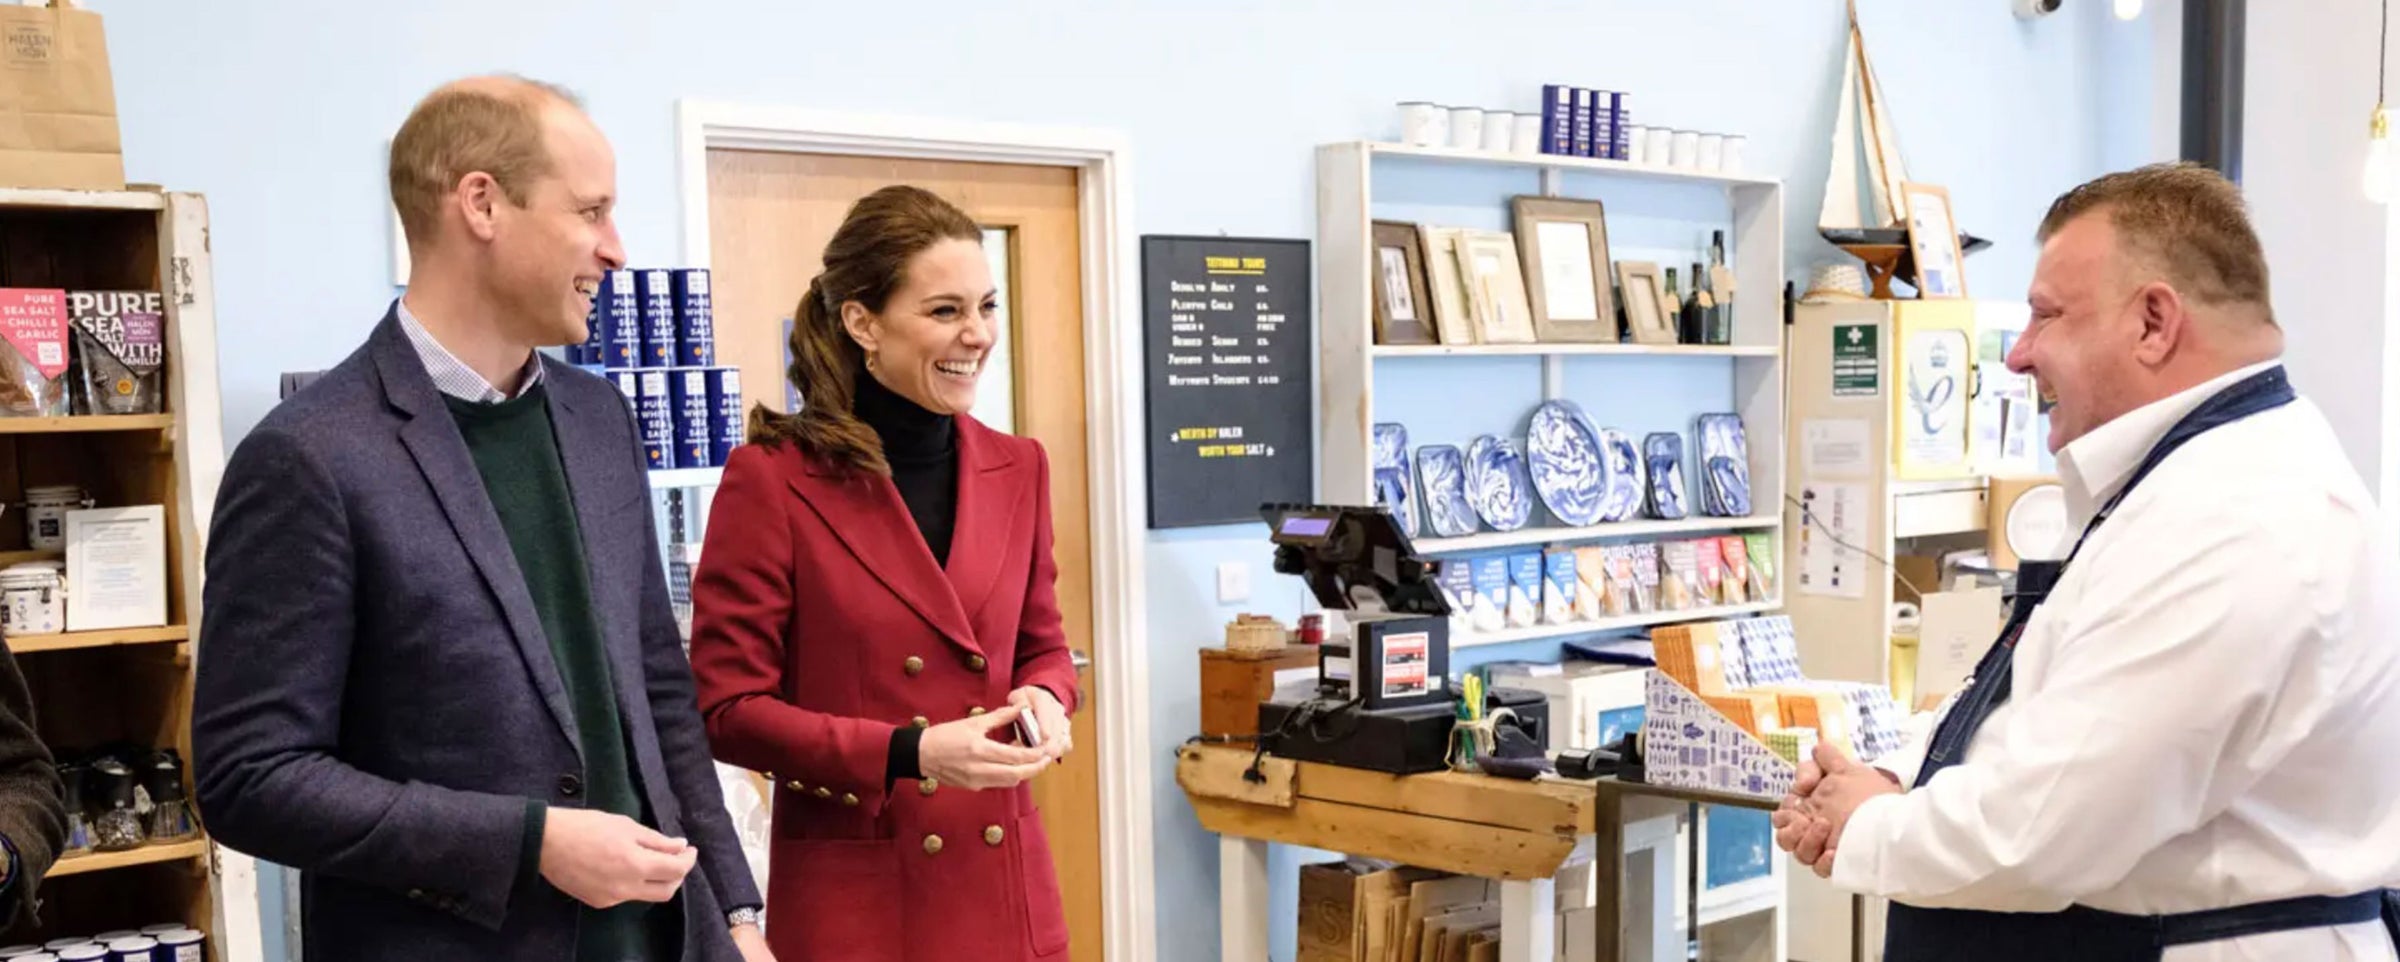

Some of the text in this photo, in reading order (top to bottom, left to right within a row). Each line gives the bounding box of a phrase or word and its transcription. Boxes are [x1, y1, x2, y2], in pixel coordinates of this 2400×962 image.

[3, 306, 56, 315] SEA SALT
[72, 292, 162, 316] PURE
[81, 317, 125, 333] SEA
[107, 343, 162, 358] WITH
